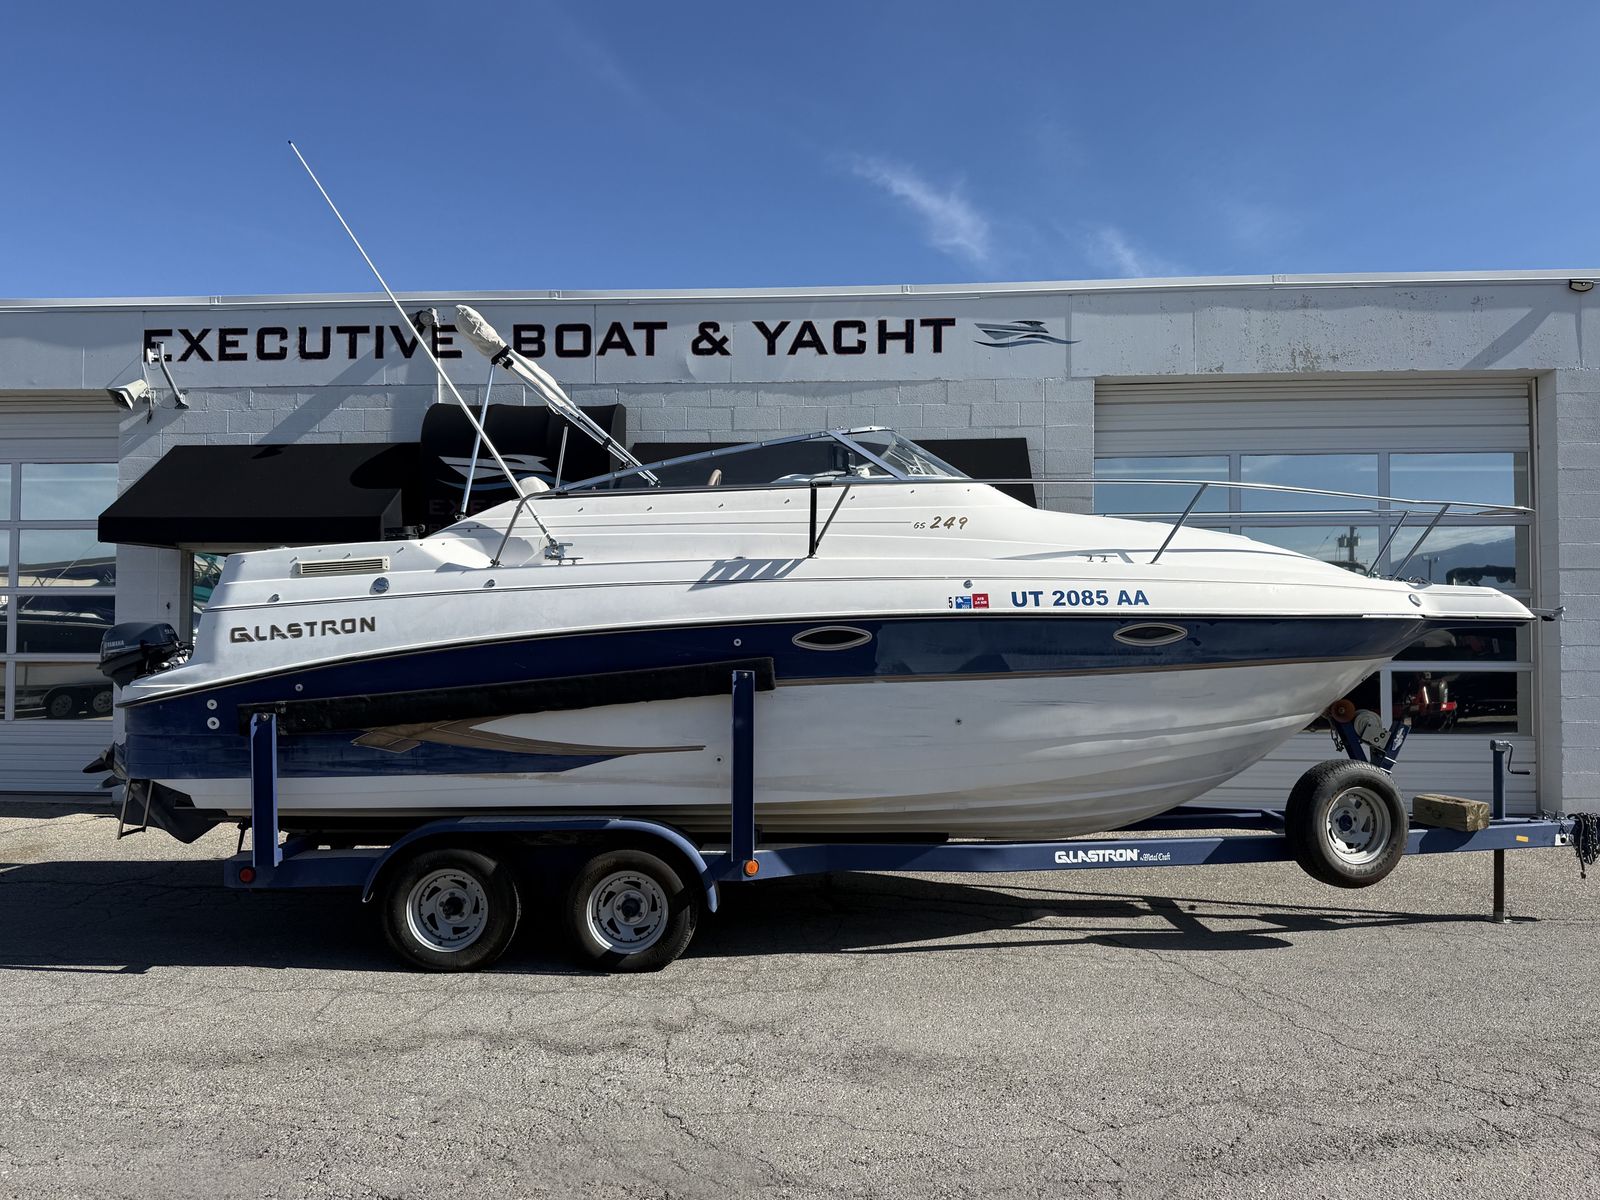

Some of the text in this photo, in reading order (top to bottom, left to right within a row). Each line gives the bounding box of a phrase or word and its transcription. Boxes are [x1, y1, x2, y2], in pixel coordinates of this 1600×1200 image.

[143, 317, 957, 363] EXECUTIVE BOAT & YACHT
[913, 515, 969, 530] GS 249
[948, 596, 953, 609] 5
[1011, 589, 1150, 608] UT 2085 AA
[229, 615, 376, 644] GLASTRON
[1054, 848, 1138, 864] GLASTRON
